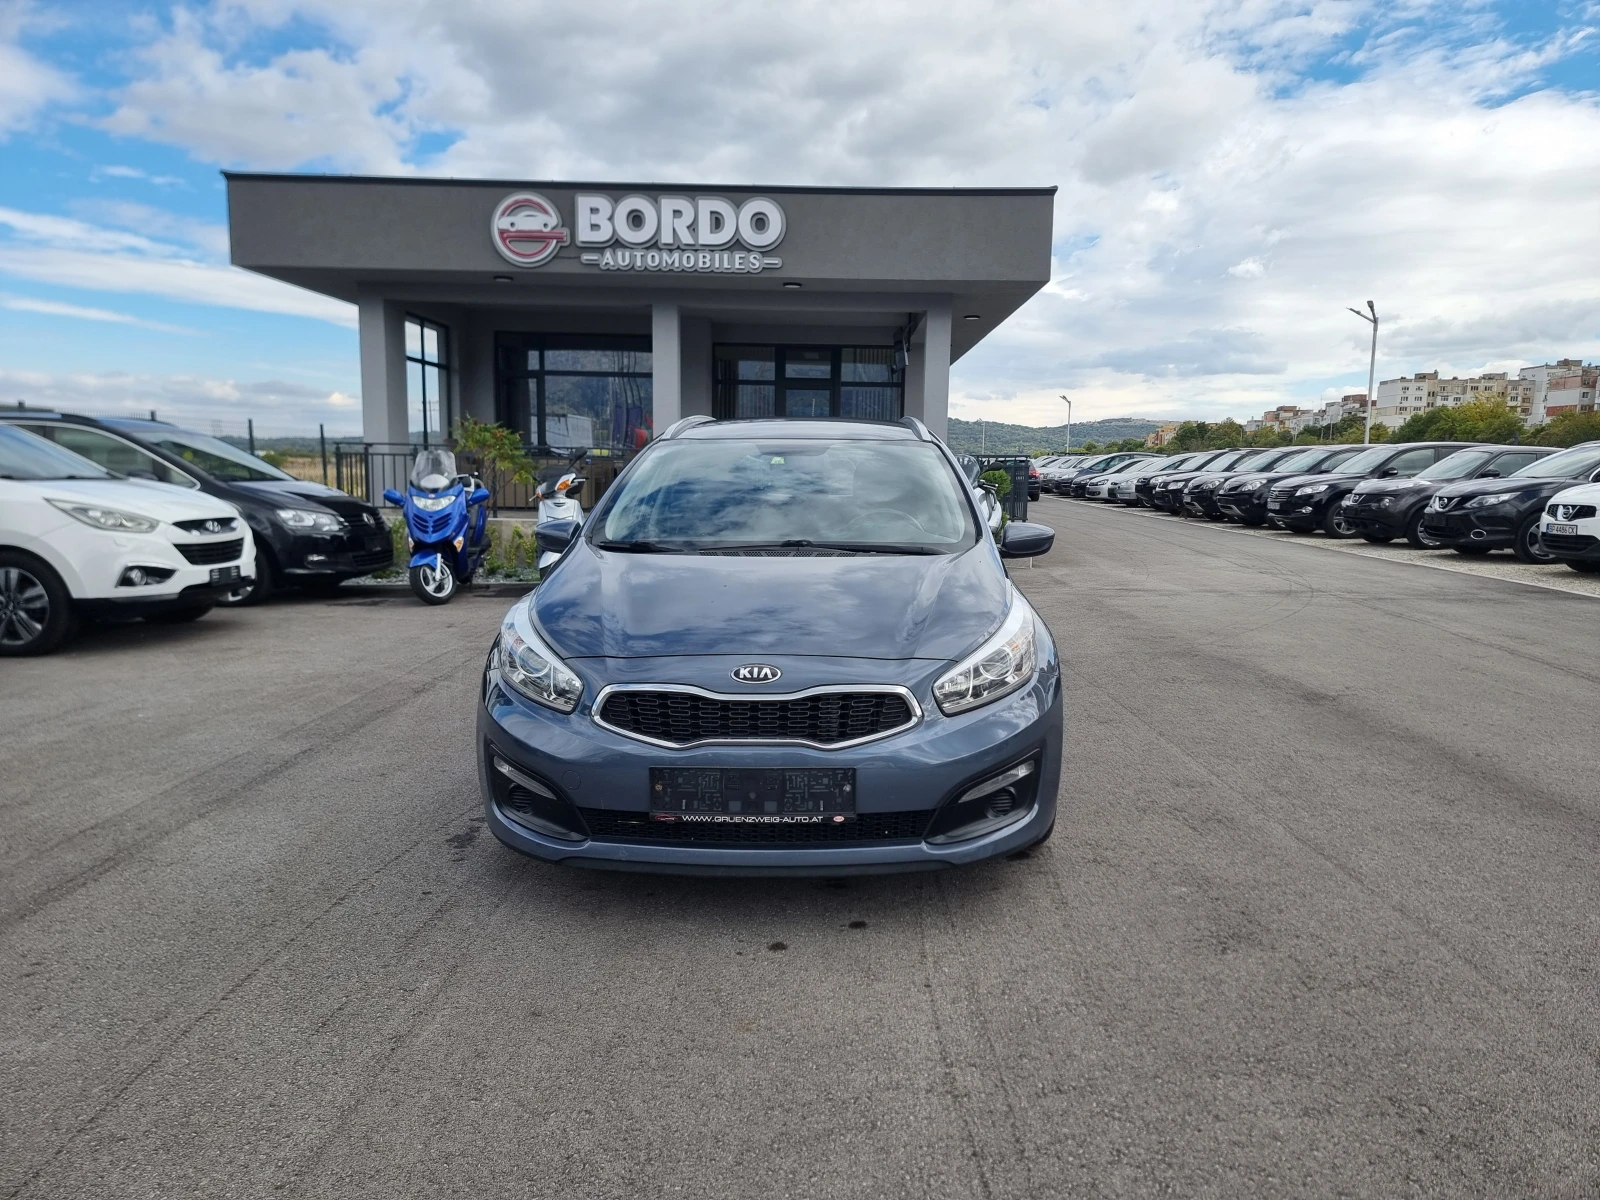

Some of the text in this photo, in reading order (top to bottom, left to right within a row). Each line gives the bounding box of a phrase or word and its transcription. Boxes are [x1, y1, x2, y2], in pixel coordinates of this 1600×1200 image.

[577, 195, 783, 248] BORDO
[600, 250, 761, 271] AUTOMOBILES
[1567, 526, 1576, 535] CK
[739, 667, 773, 679] KIA
[681, 815, 824, 824] WWW.GRUENZWEIG-AUTO.AT
